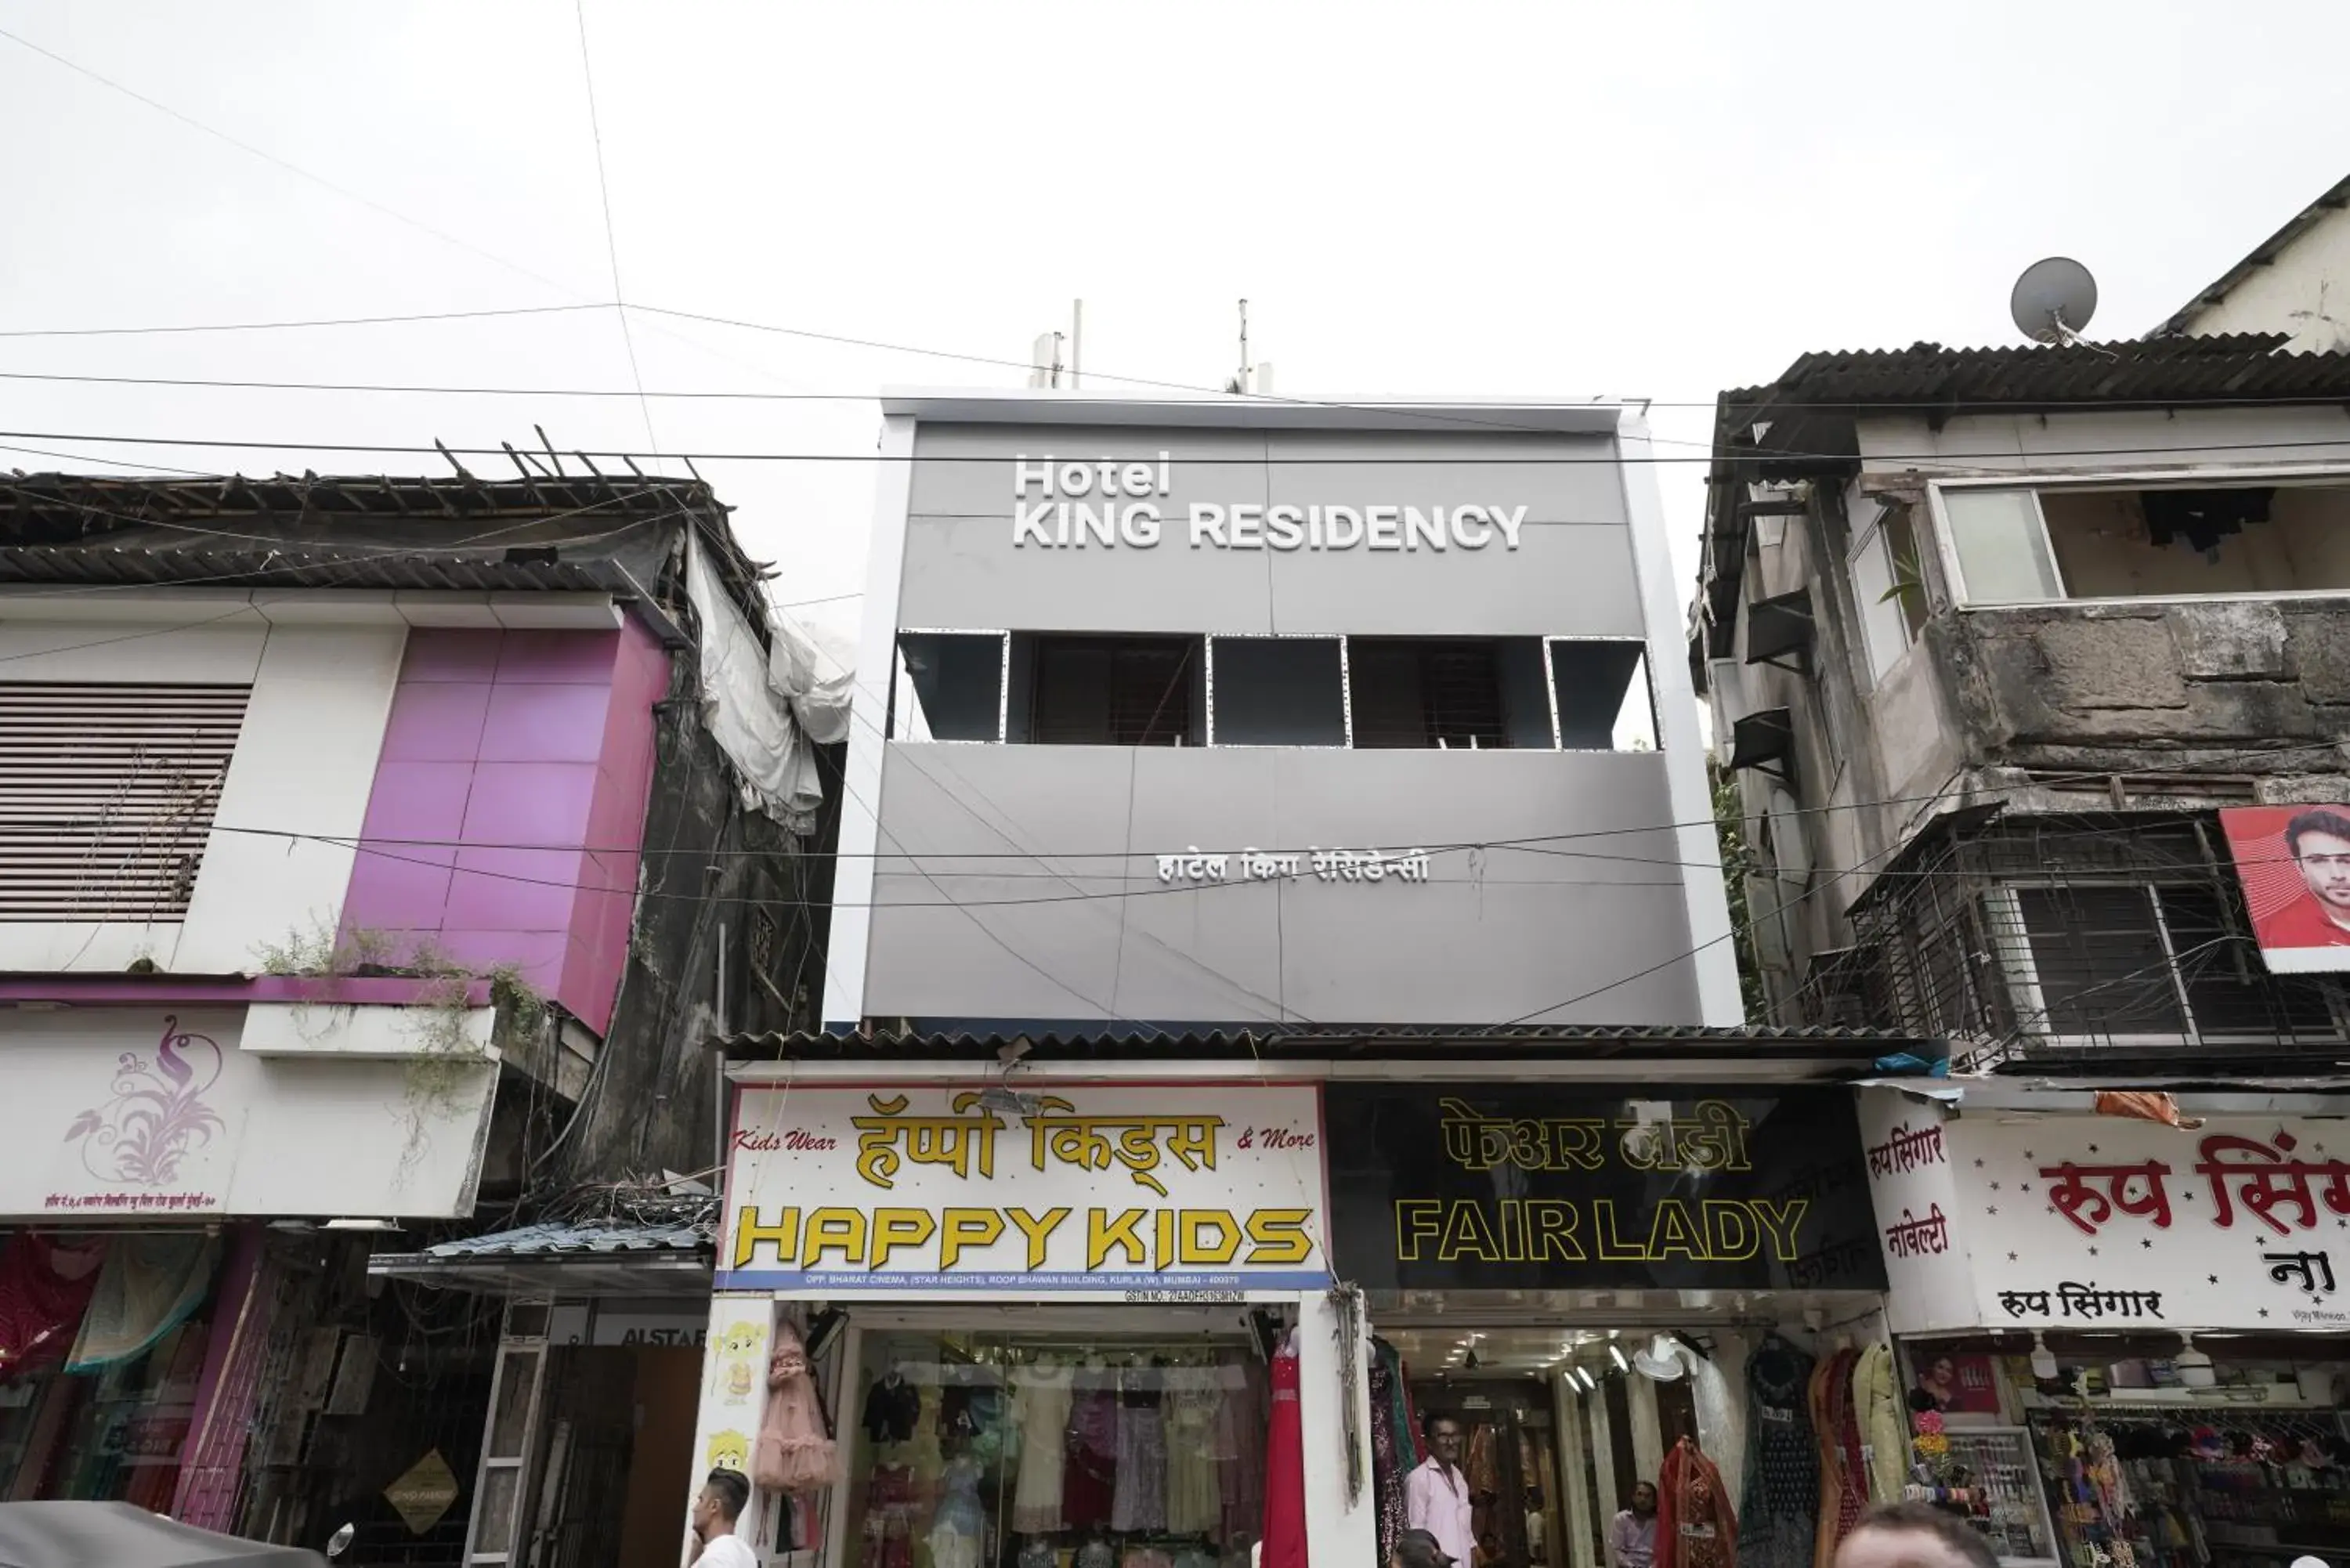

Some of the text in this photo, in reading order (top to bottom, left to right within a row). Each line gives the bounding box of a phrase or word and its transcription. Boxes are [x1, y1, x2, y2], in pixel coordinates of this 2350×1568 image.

[1014, 452, 1170, 497] Hotel
[1012, 502, 1528, 550] KING RESIDENCY
[730, 1129, 837, 1151] Kids Wear
[1021, 1096, 1226, 1198] किड्स
[1237, 1126, 1315, 1150] & More
[733, 1205, 1315, 1272] HAPPY KIDS
[1395, 1200, 1808, 1261] FAIR LADY
[1162, 1275, 1201, 1285] MUMBAI
[2056, 1281, 2164, 1321] सिंगार
